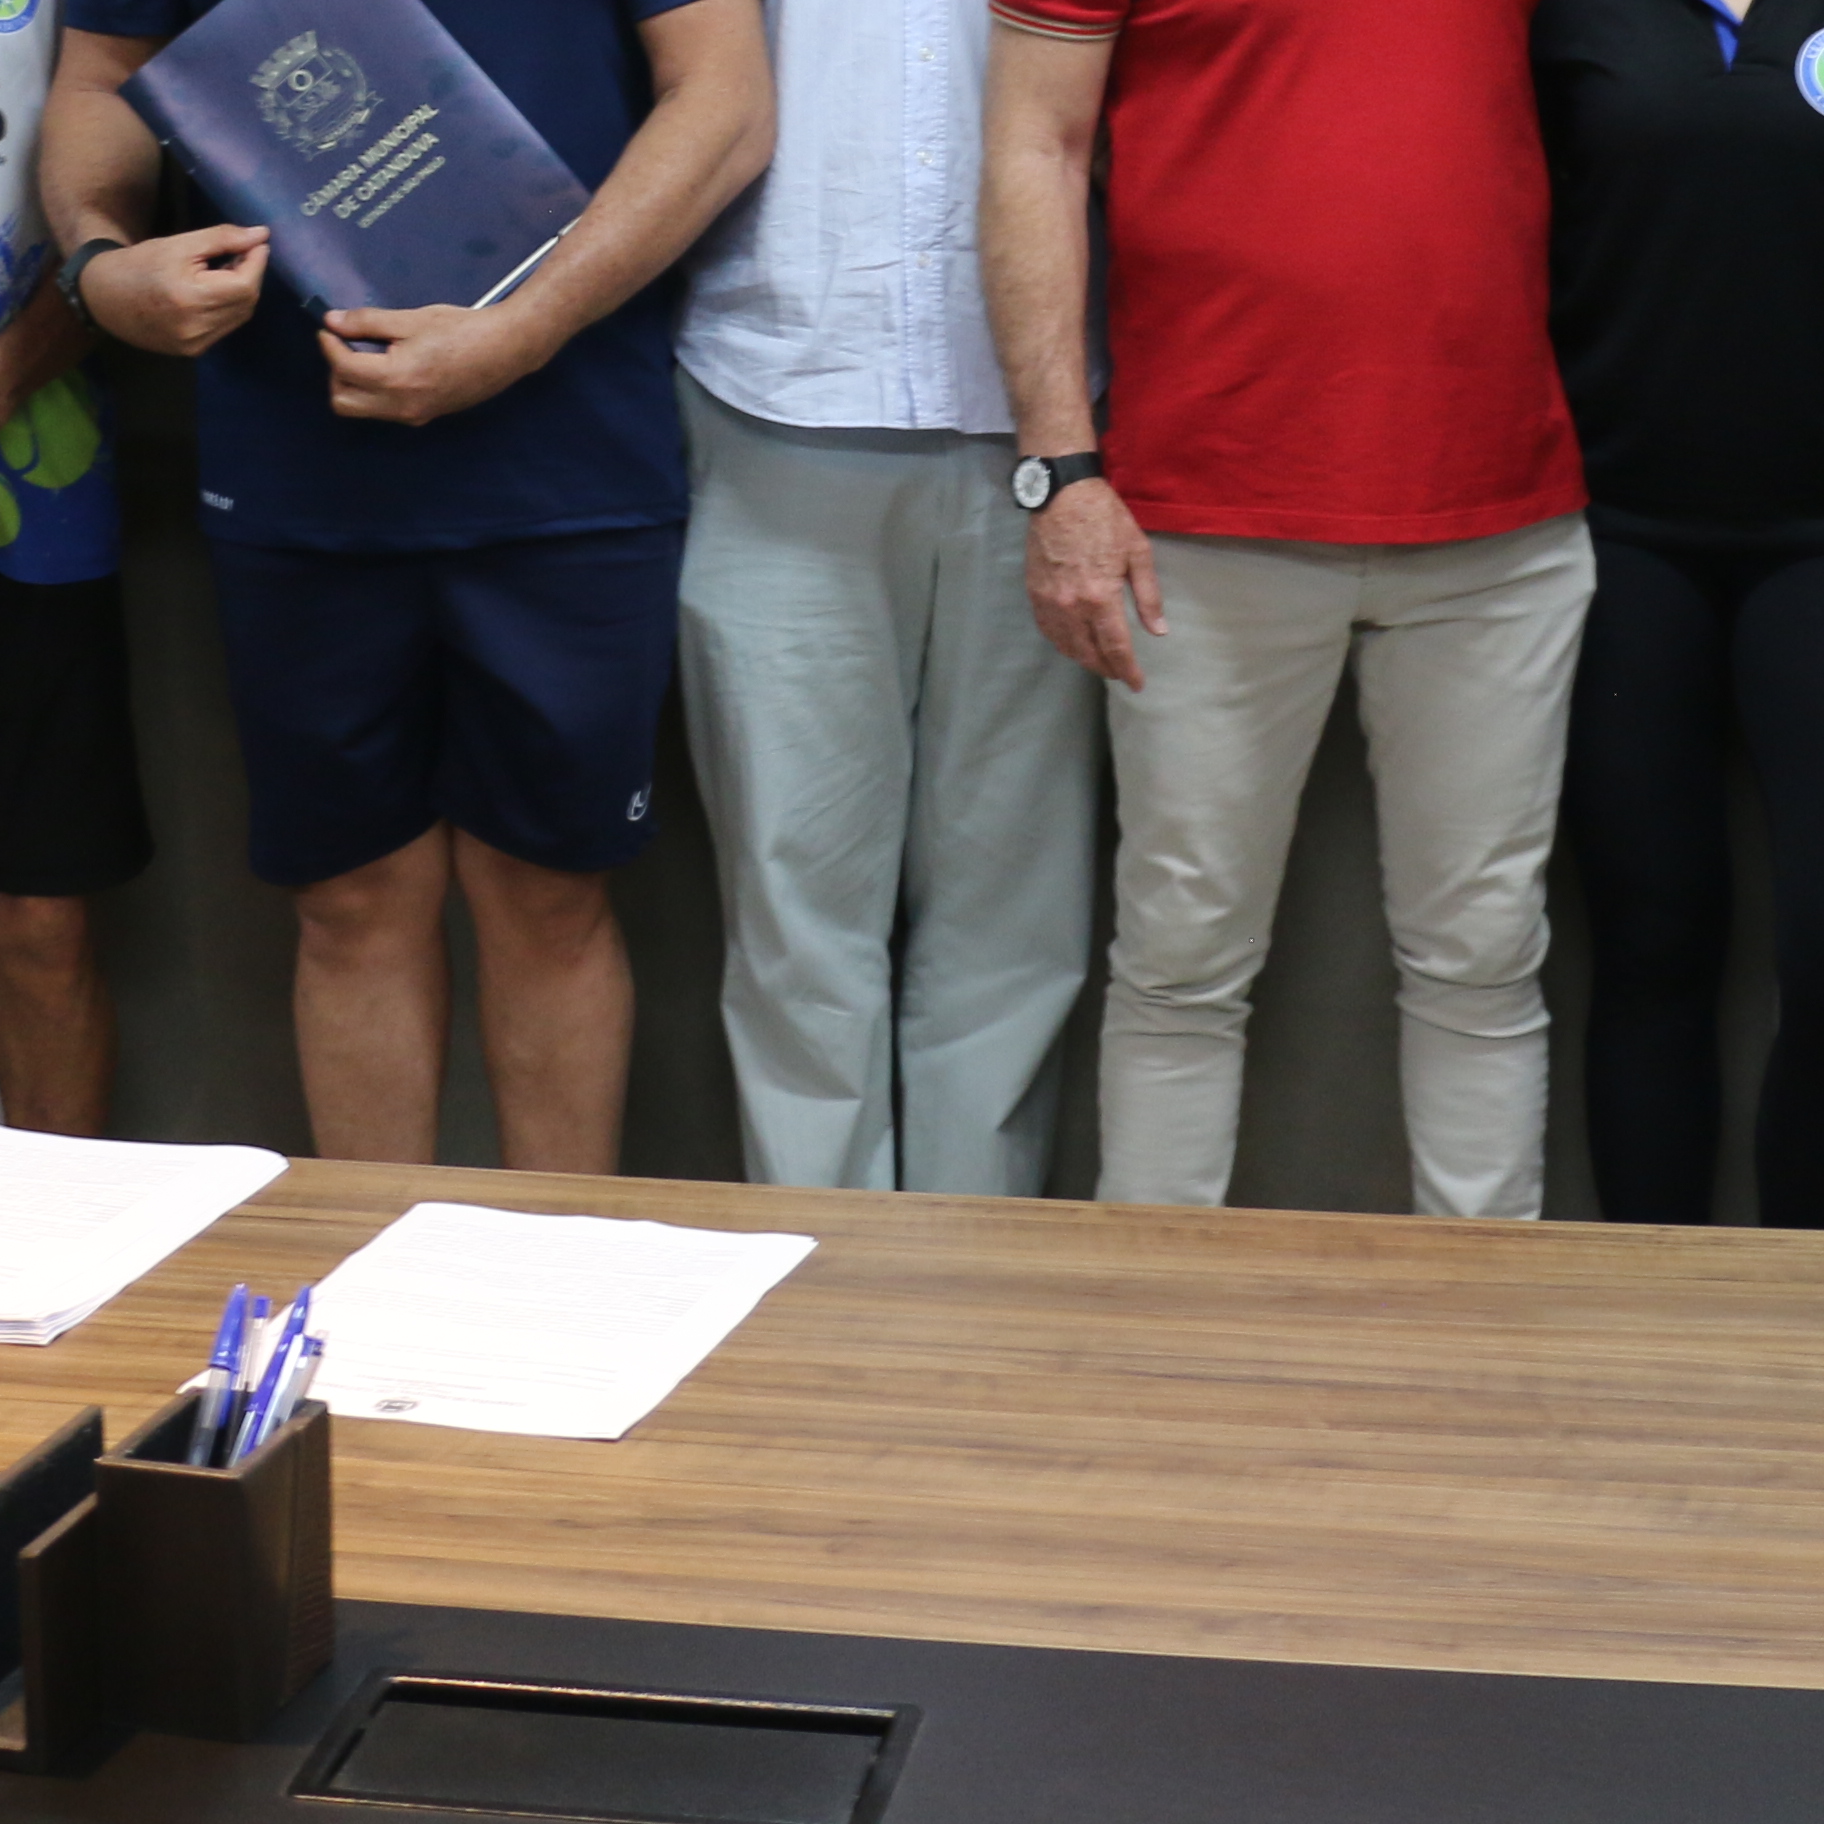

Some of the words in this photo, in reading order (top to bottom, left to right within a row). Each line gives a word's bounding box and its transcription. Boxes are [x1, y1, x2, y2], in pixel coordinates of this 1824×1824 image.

[358, 104, 440, 169] MUNICIPAL
[333, 194, 361, 220] DE
[355, 133, 440, 202] CATANDUVA
